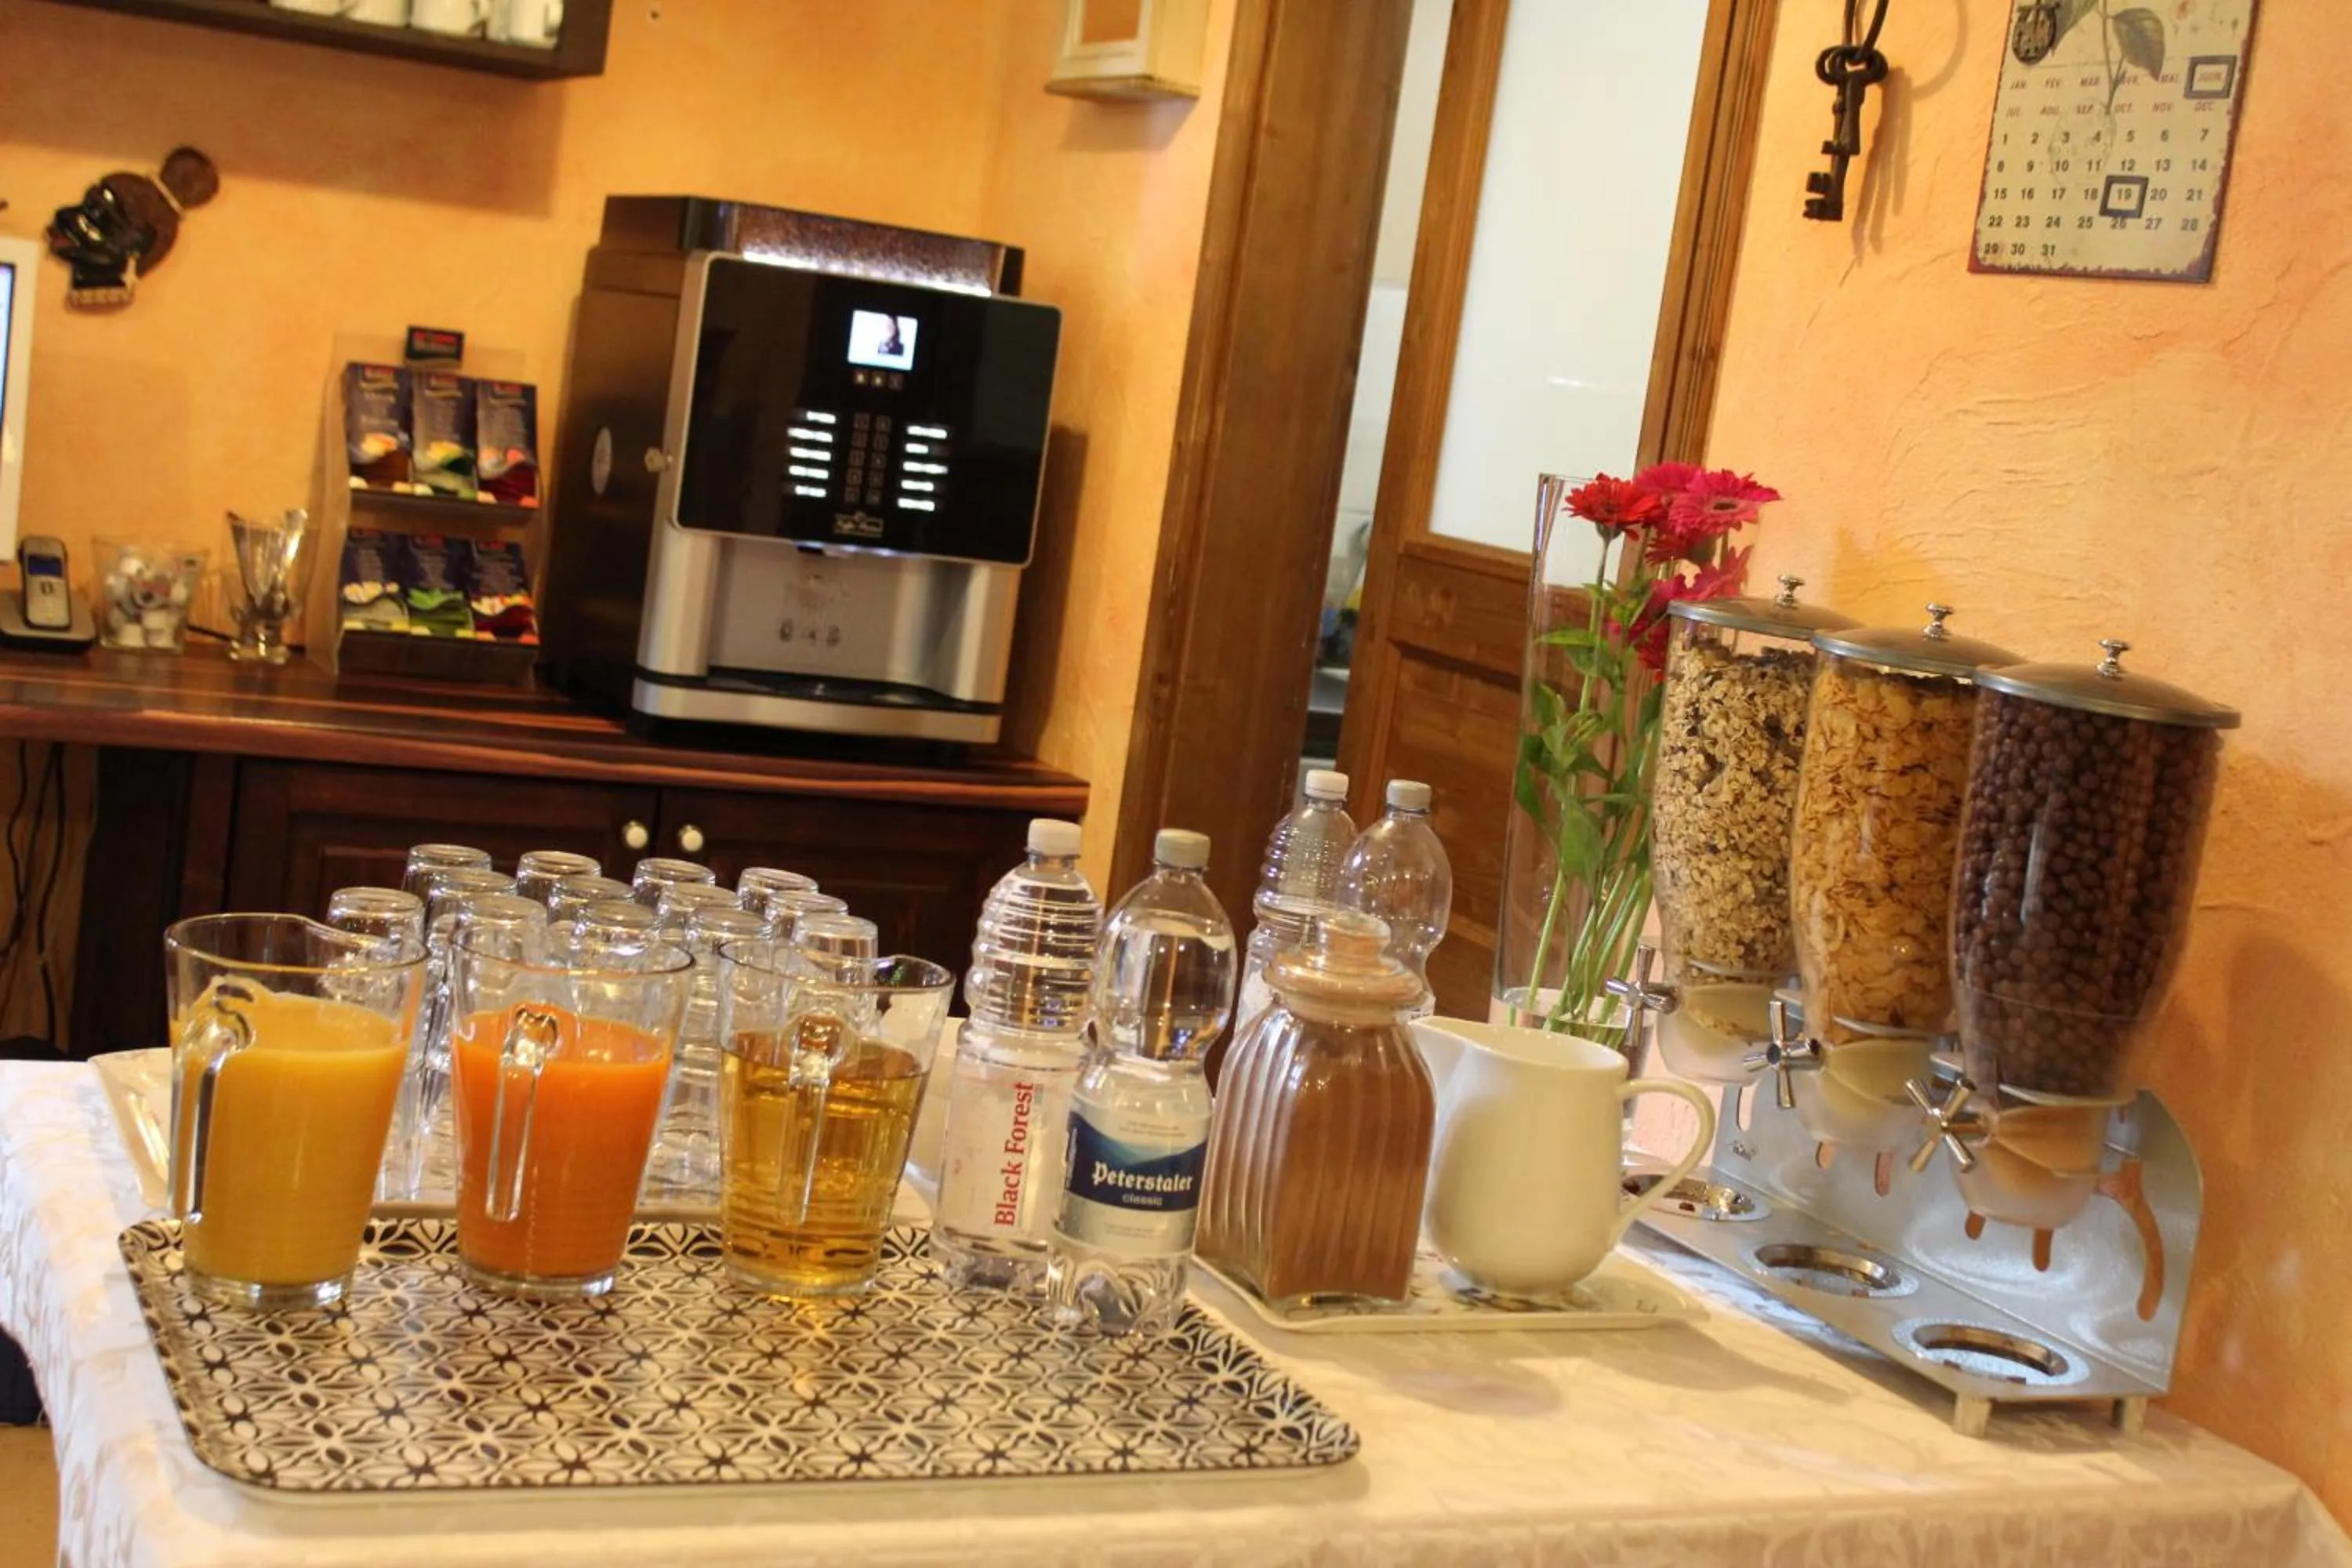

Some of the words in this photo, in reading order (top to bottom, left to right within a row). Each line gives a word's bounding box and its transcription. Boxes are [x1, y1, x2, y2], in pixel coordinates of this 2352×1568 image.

[2031, 132, 2039, 144] 2
[2062, 131, 2071, 143] 3
[2092, 131, 2101, 143] 4
[2126, 129, 2136, 143] 5
[2161, 129, 2169, 142] 6
[2199, 128, 2209, 143] 7
[1997, 160, 2005, 172] 8
[2027, 160, 2034, 172] 9
[2055, 159, 2070, 172] 10
[2087, 159, 2103, 172] 11
[2121, 158, 2136, 172] 12
[2155, 158, 2171, 172] 13
[2191, 158, 2208, 171] 14
[1994, 188, 2007, 200] 15
[2021, 188, 2034, 200] 16
[2052, 187, 2067, 201] 17
[2084, 187, 2098, 201] 18
[2117, 187, 2132, 201] 19
[2150, 187, 2168, 201] 20
[2185, 188, 2204, 201] 21
[1988, 215, 2003, 228] 22
[2015, 215, 2031, 228] 23
[2045, 216, 2061, 229] 24
[2078, 216, 2094, 230] 25
[2111, 217, 2127, 230] 26
[2144, 217, 2163, 230] 27
[2180, 217, 2199, 232] 28
[1984, 242, 1999, 255] 29
[2010, 242, 2025, 256] 30
[2042, 243, 2056, 256] 31
[1004, 1082, 1034, 1155] Forest
[1091, 1160, 1193, 1192] Peterstaler
[994, 1161, 1022, 1226] Black
